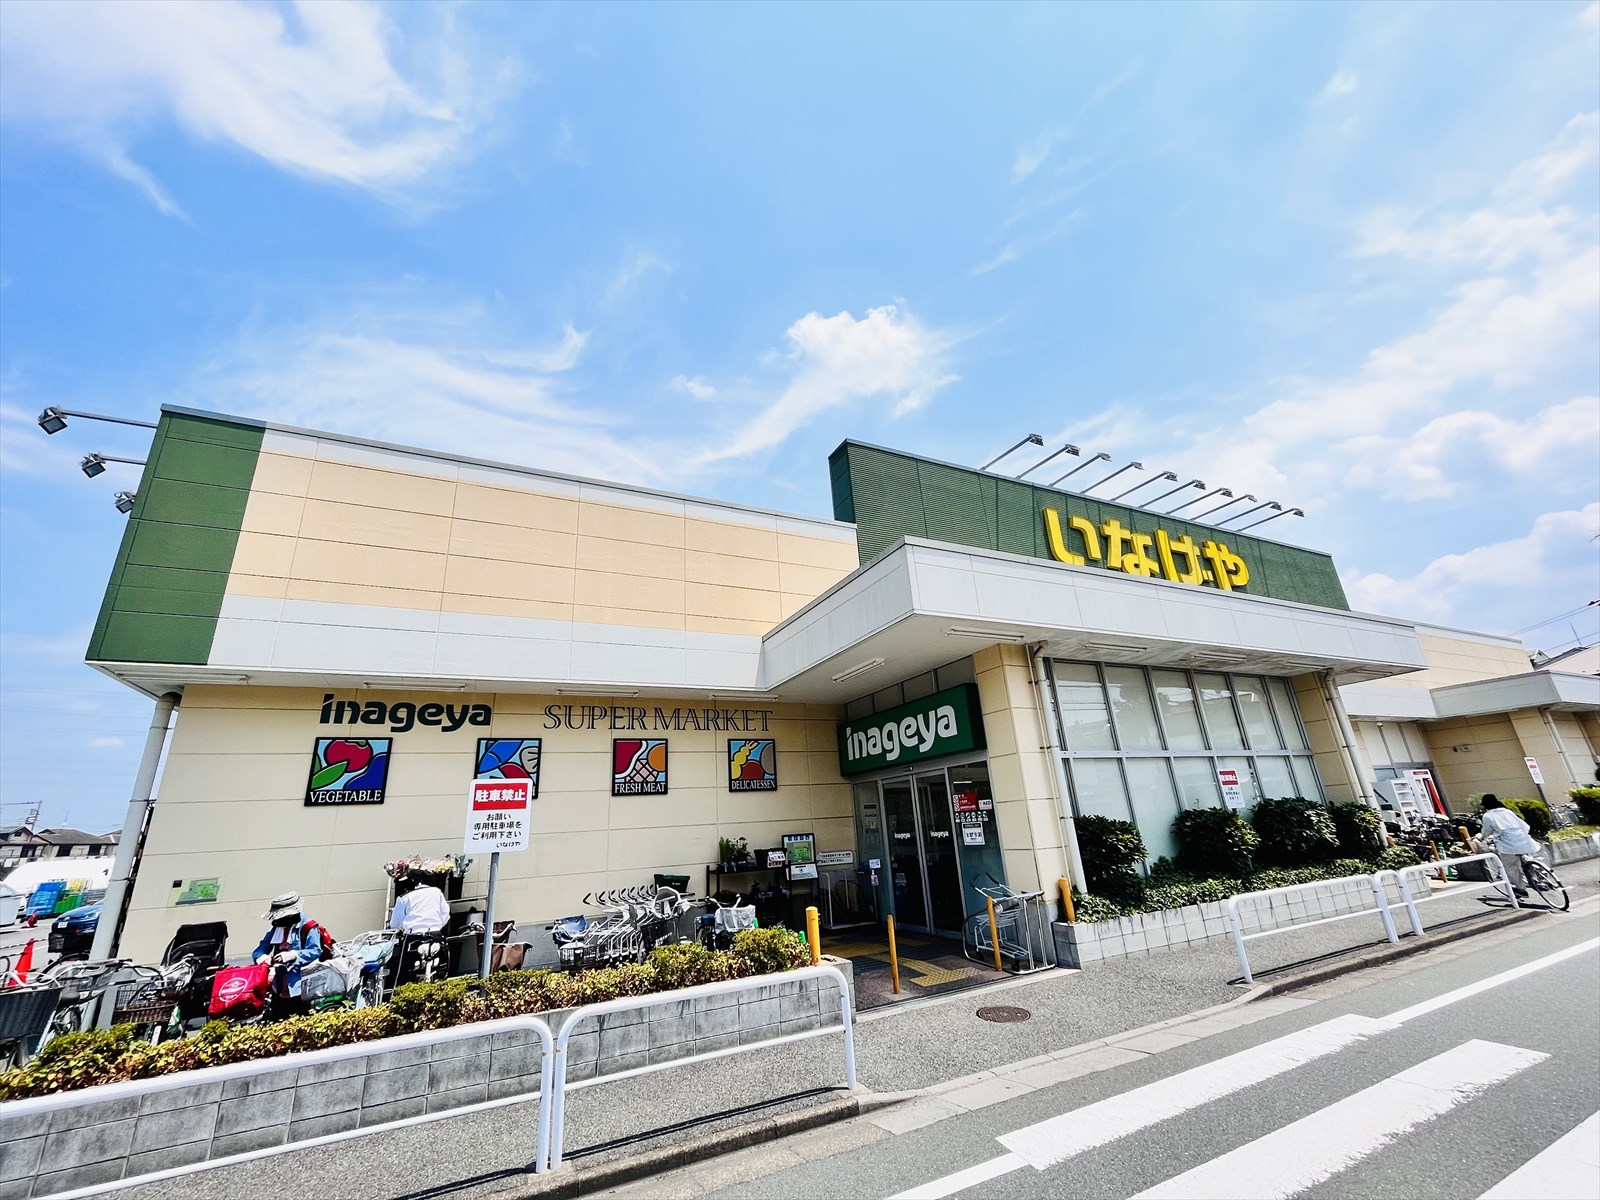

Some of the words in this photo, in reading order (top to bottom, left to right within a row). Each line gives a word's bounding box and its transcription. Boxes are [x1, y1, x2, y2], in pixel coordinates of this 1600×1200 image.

[1043, 507, 1250, 592] いなげや
[319, 693, 492, 733] inageya
[543, 704, 648, 730] SUPER
[653, 707, 774, 732] MARKET
[845, 704, 958, 762] inageya
[614, 782, 642, 794] FRESH
[643, 781, 666, 793] MEAT
[731, 779, 776, 790] DELICATESSEN
[309, 789, 382, 803] VEGETABLE
[475, 789, 526, 802] 駐車禁止
[486, 813, 511, 822] お願い
[473, 821, 522, 831] 専用駐車場を
[472, 831, 521, 840] ご利用下さい
